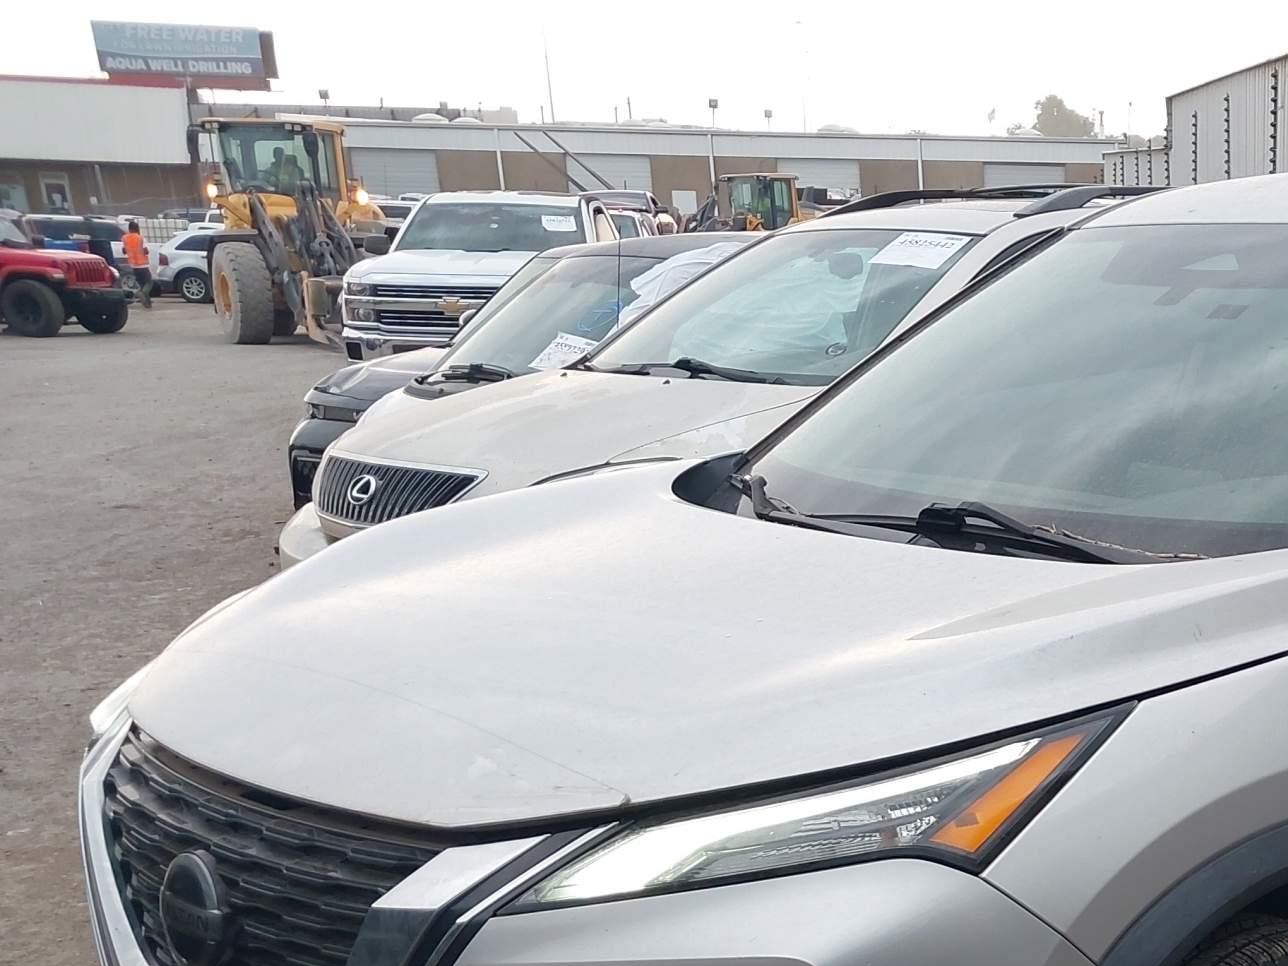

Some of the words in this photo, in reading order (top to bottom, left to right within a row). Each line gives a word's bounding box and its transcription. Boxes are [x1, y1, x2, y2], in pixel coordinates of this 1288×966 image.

[126, 24, 172, 40] FREE
[179, 27, 243, 43] WATER
[106, 57, 146, 70] AQUA
[149, 58, 183, 71] WELL
[189, 61, 252, 74] DRILLING
